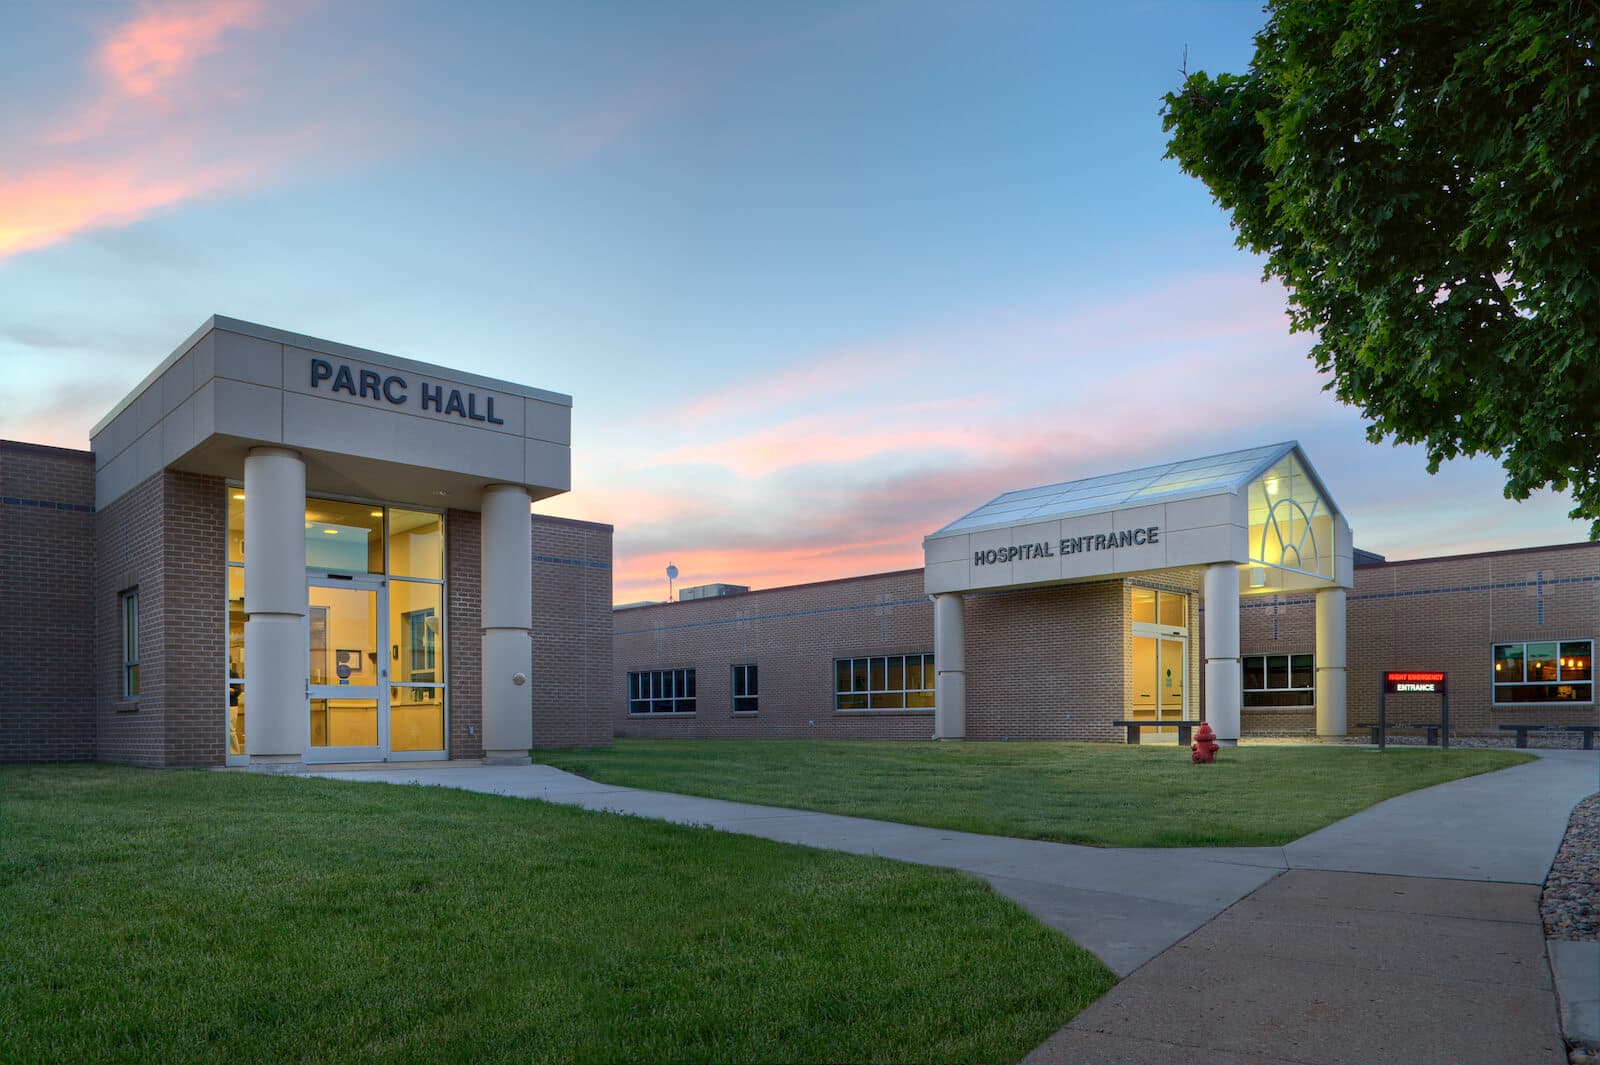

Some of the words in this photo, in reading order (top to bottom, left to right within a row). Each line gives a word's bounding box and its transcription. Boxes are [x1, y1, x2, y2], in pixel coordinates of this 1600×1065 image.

[311, 358, 408, 405] PARC
[421, 382, 504, 425] HALL
[974, 541, 1054, 566] HOSPITAL
[1059, 526, 1160, 556] ENTRANCE
[1397, 683, 1435, 691] ENTRANCE
